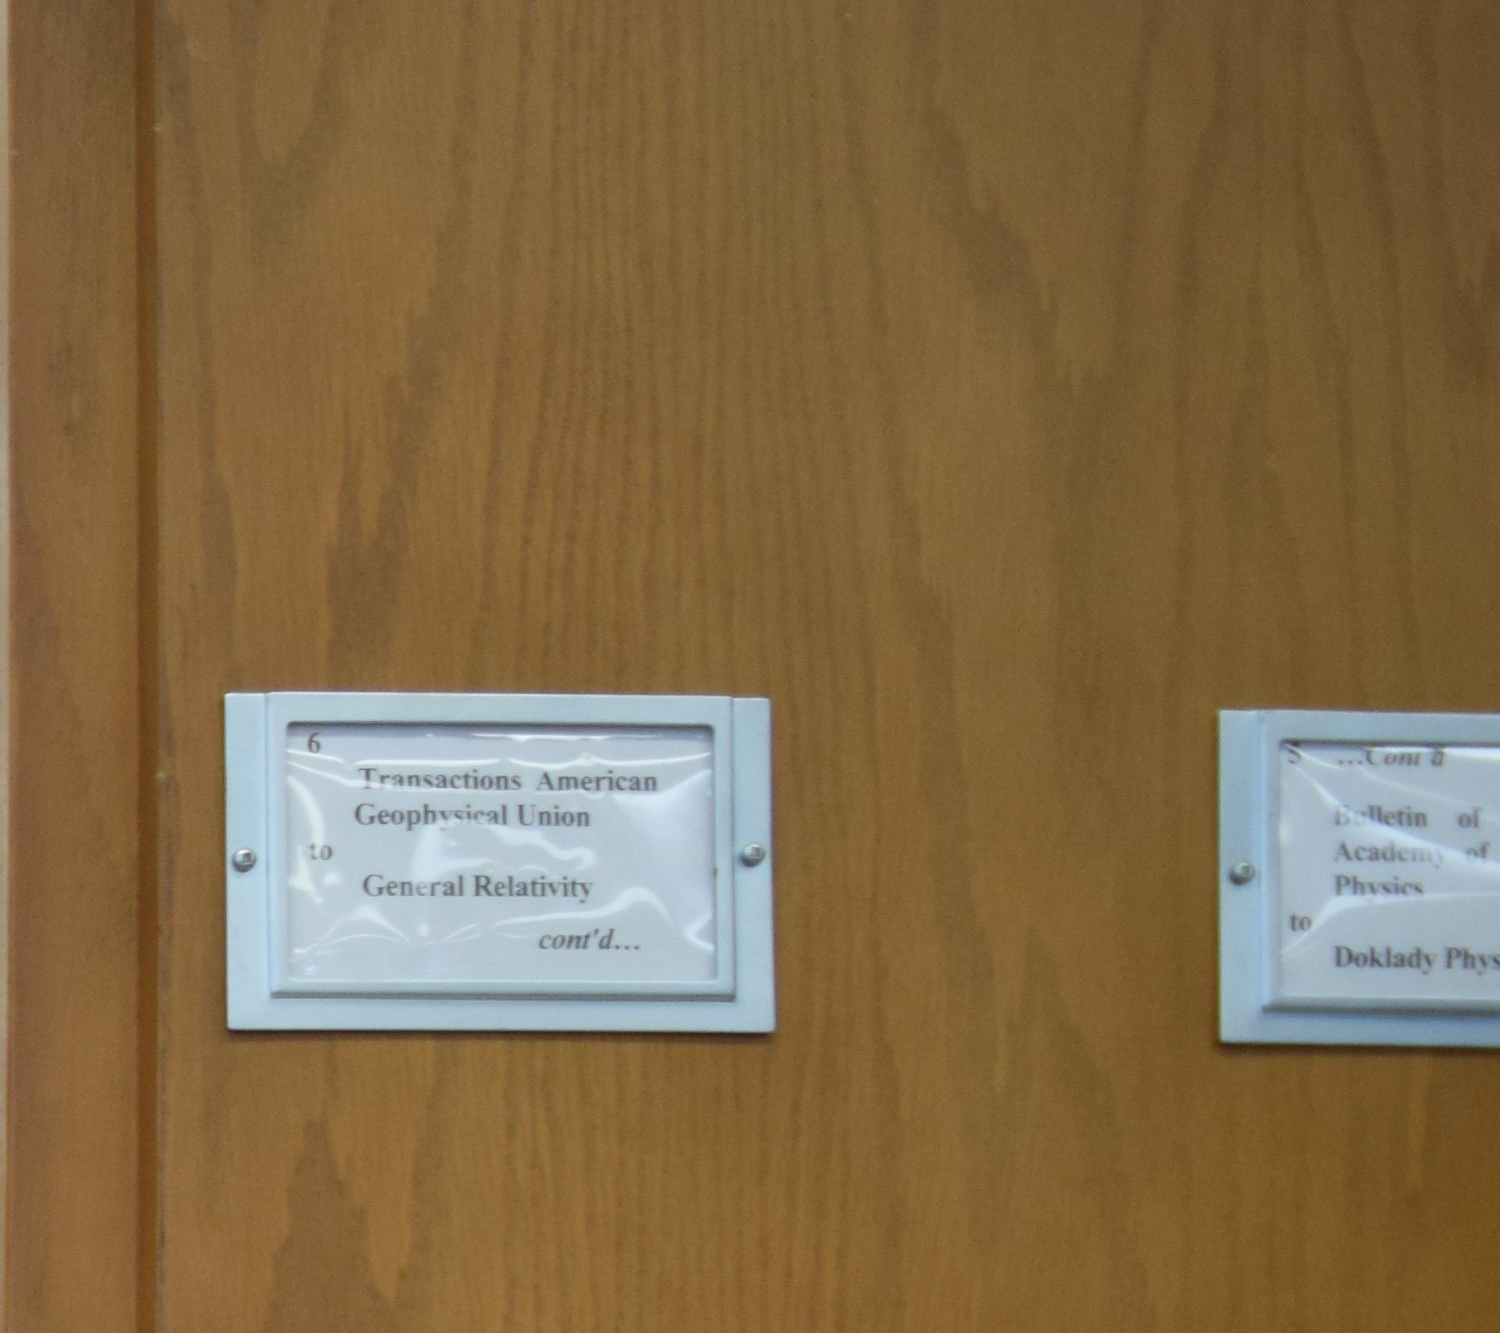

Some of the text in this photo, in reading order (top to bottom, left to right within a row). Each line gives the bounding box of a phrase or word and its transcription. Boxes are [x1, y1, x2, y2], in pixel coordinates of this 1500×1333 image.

[307, 732, 322, 754] 6
[358, 768, 658, 792] Transactions American
[355, 804, 591, 831] Geophysical Union
[1335, 805, 1482, 829] Bulletin of
[309, 843, 333, 861] to
[1335, 841, 1490, 868] Academy of
[362, 875, 593, 903] General Relativity
[1335, 875, 1424, 897] Physics
[1290, 915, 1312, 932] to
[1335, 946, 1437, 976] Doklady
